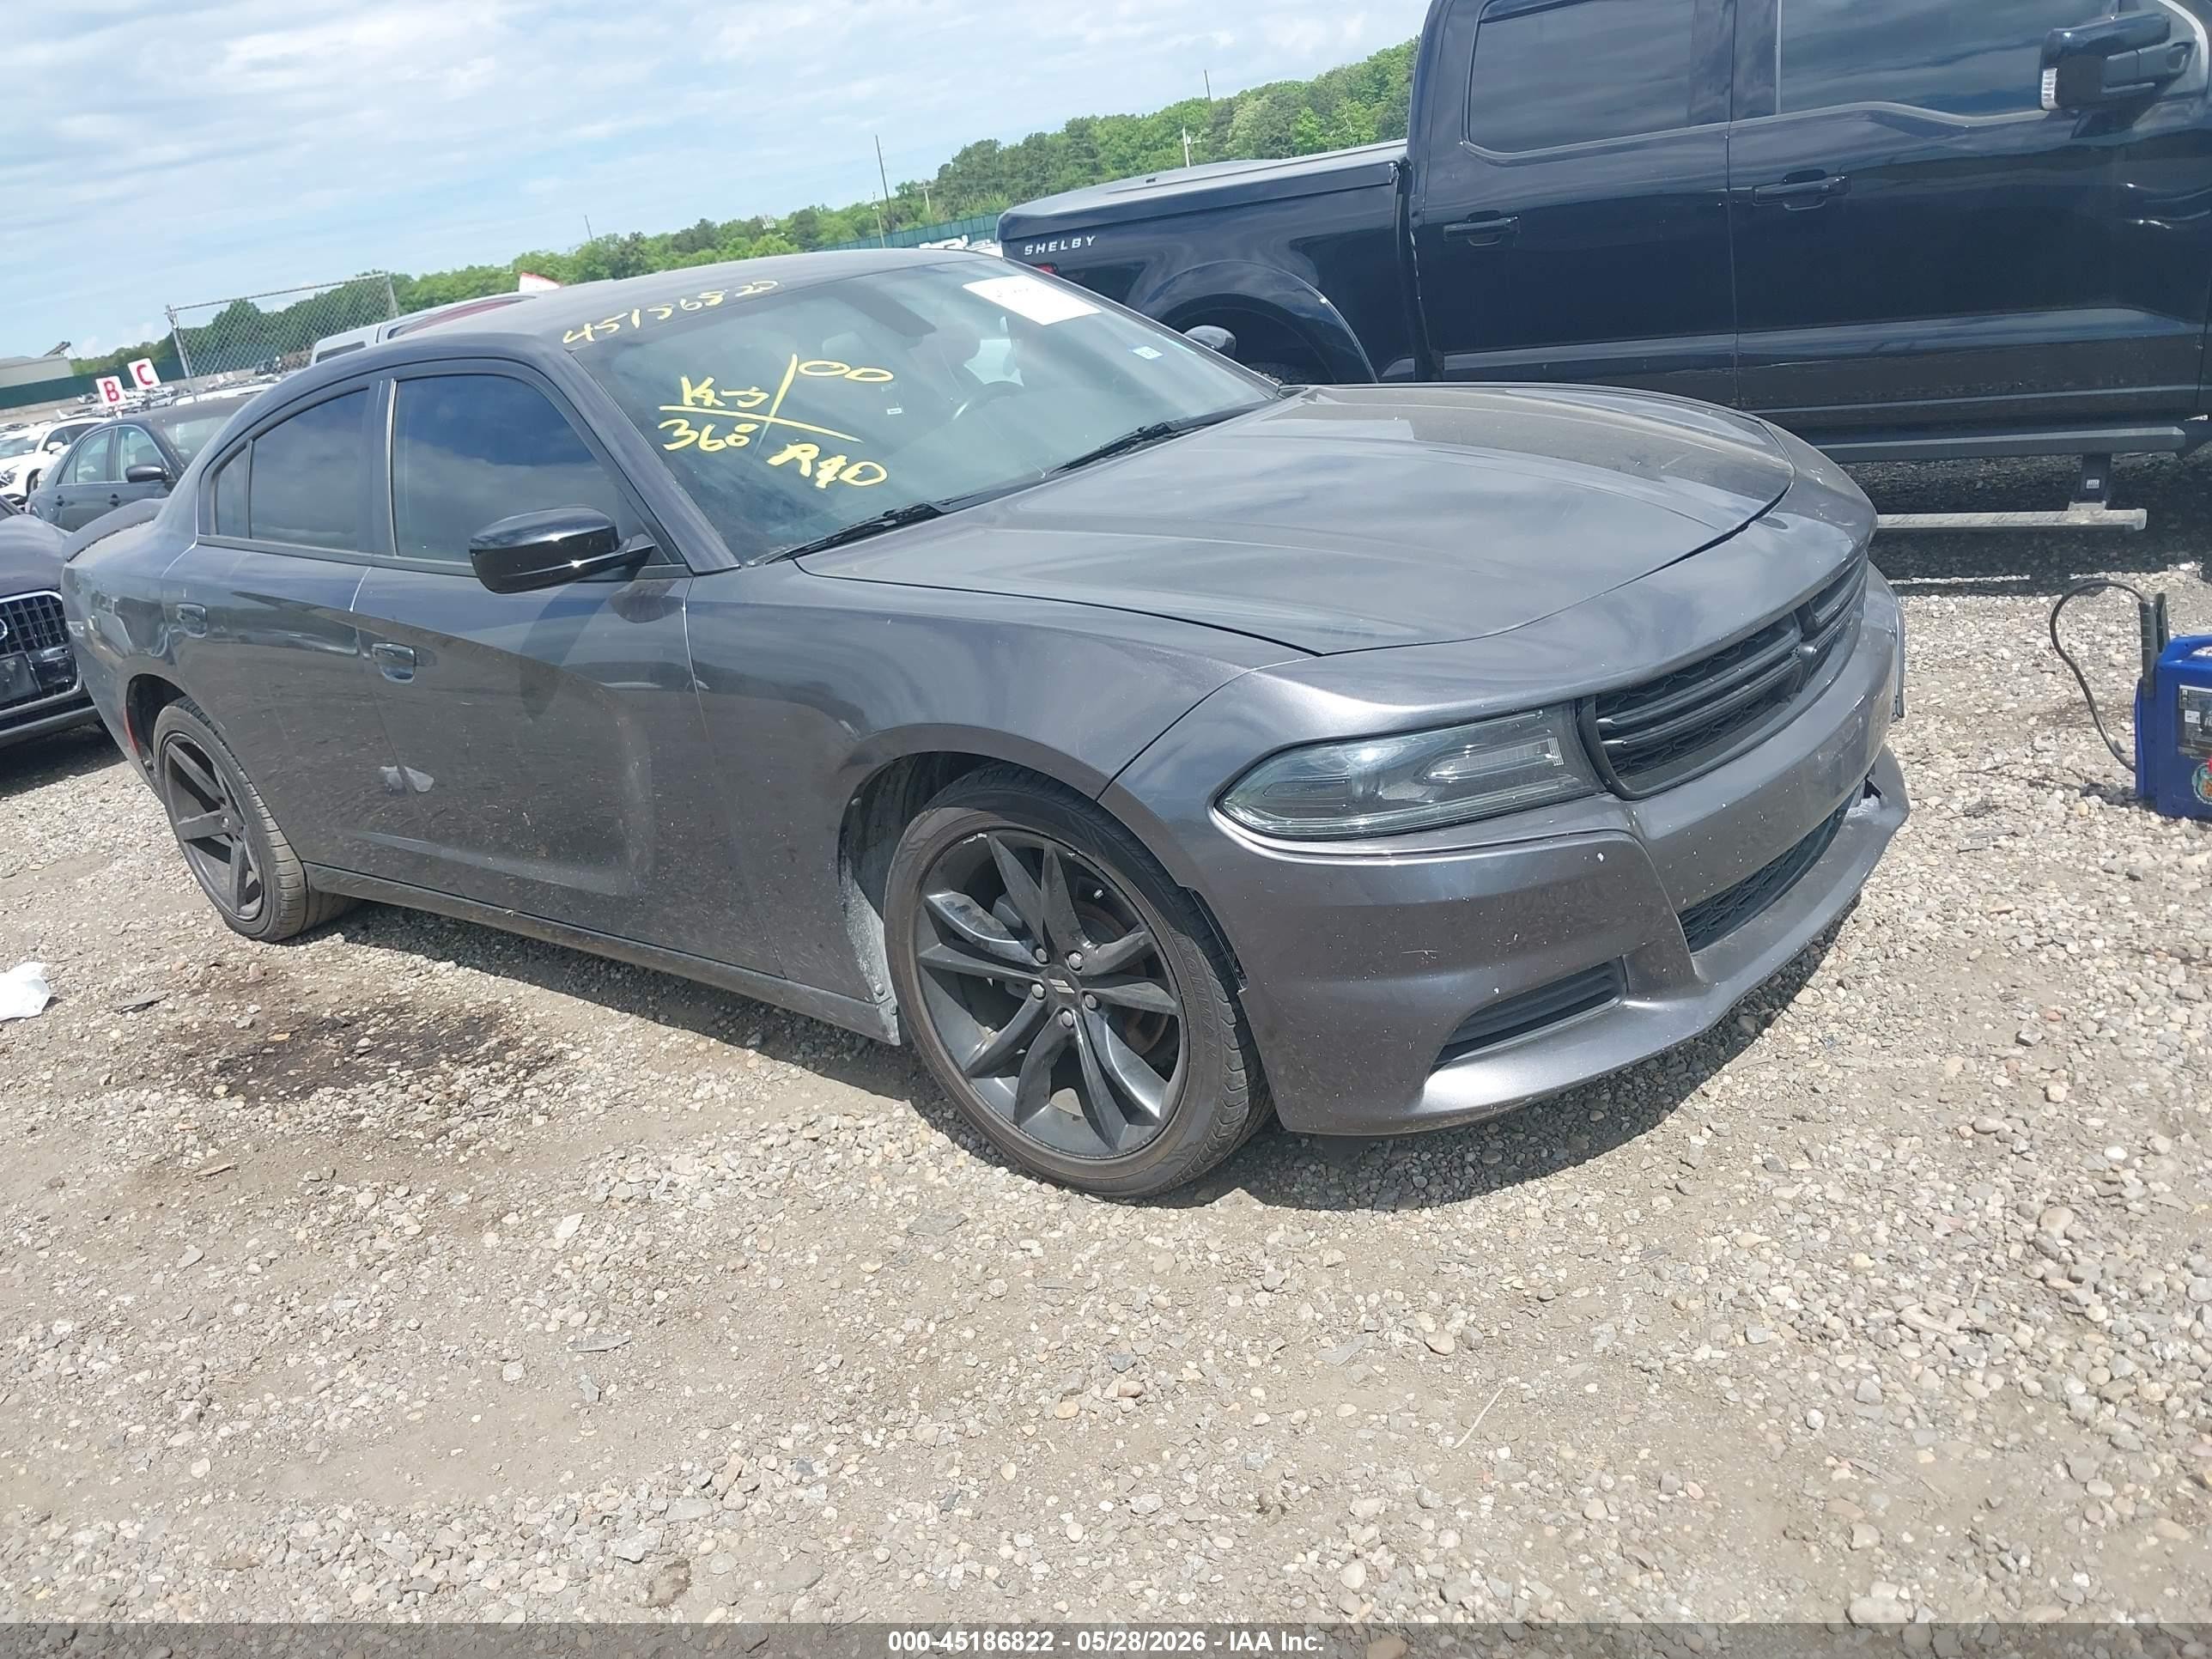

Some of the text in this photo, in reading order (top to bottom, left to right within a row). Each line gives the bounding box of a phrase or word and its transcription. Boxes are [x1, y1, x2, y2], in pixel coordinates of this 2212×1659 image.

[1024, 235, 1097, 257] SHELBY
[137, 364, 154, 385] C
[103, 380, 120, 402] B
